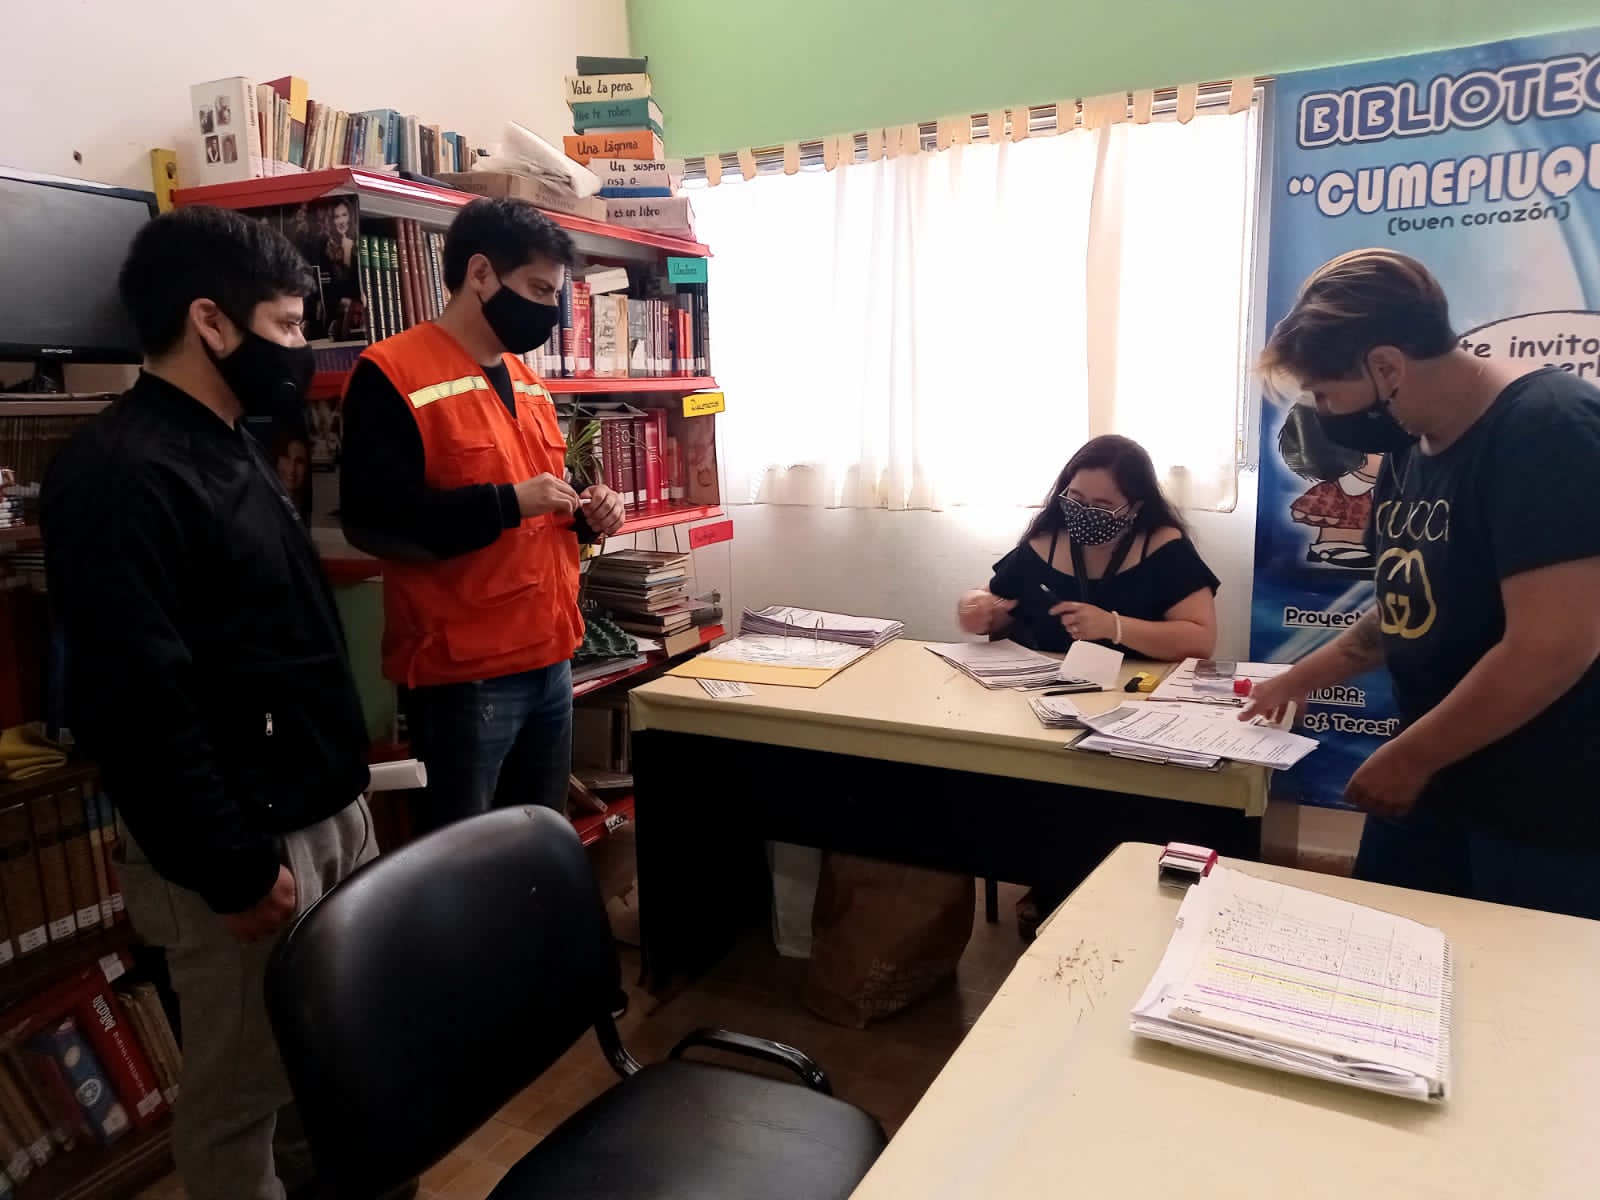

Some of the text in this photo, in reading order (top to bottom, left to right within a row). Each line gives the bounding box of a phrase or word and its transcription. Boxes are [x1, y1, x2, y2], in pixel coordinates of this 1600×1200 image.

[571, 80, 593, 95] Vale
[611, 82, 634, 99] pena
[577, 141, 599, 155] Una
[609, 161, 626, 172] Un
[1387, 201, 1571, 236] (buen corazón)
[1460, 333, 1600, 358] te invito
[1304, 713, 1330, 731] of.
